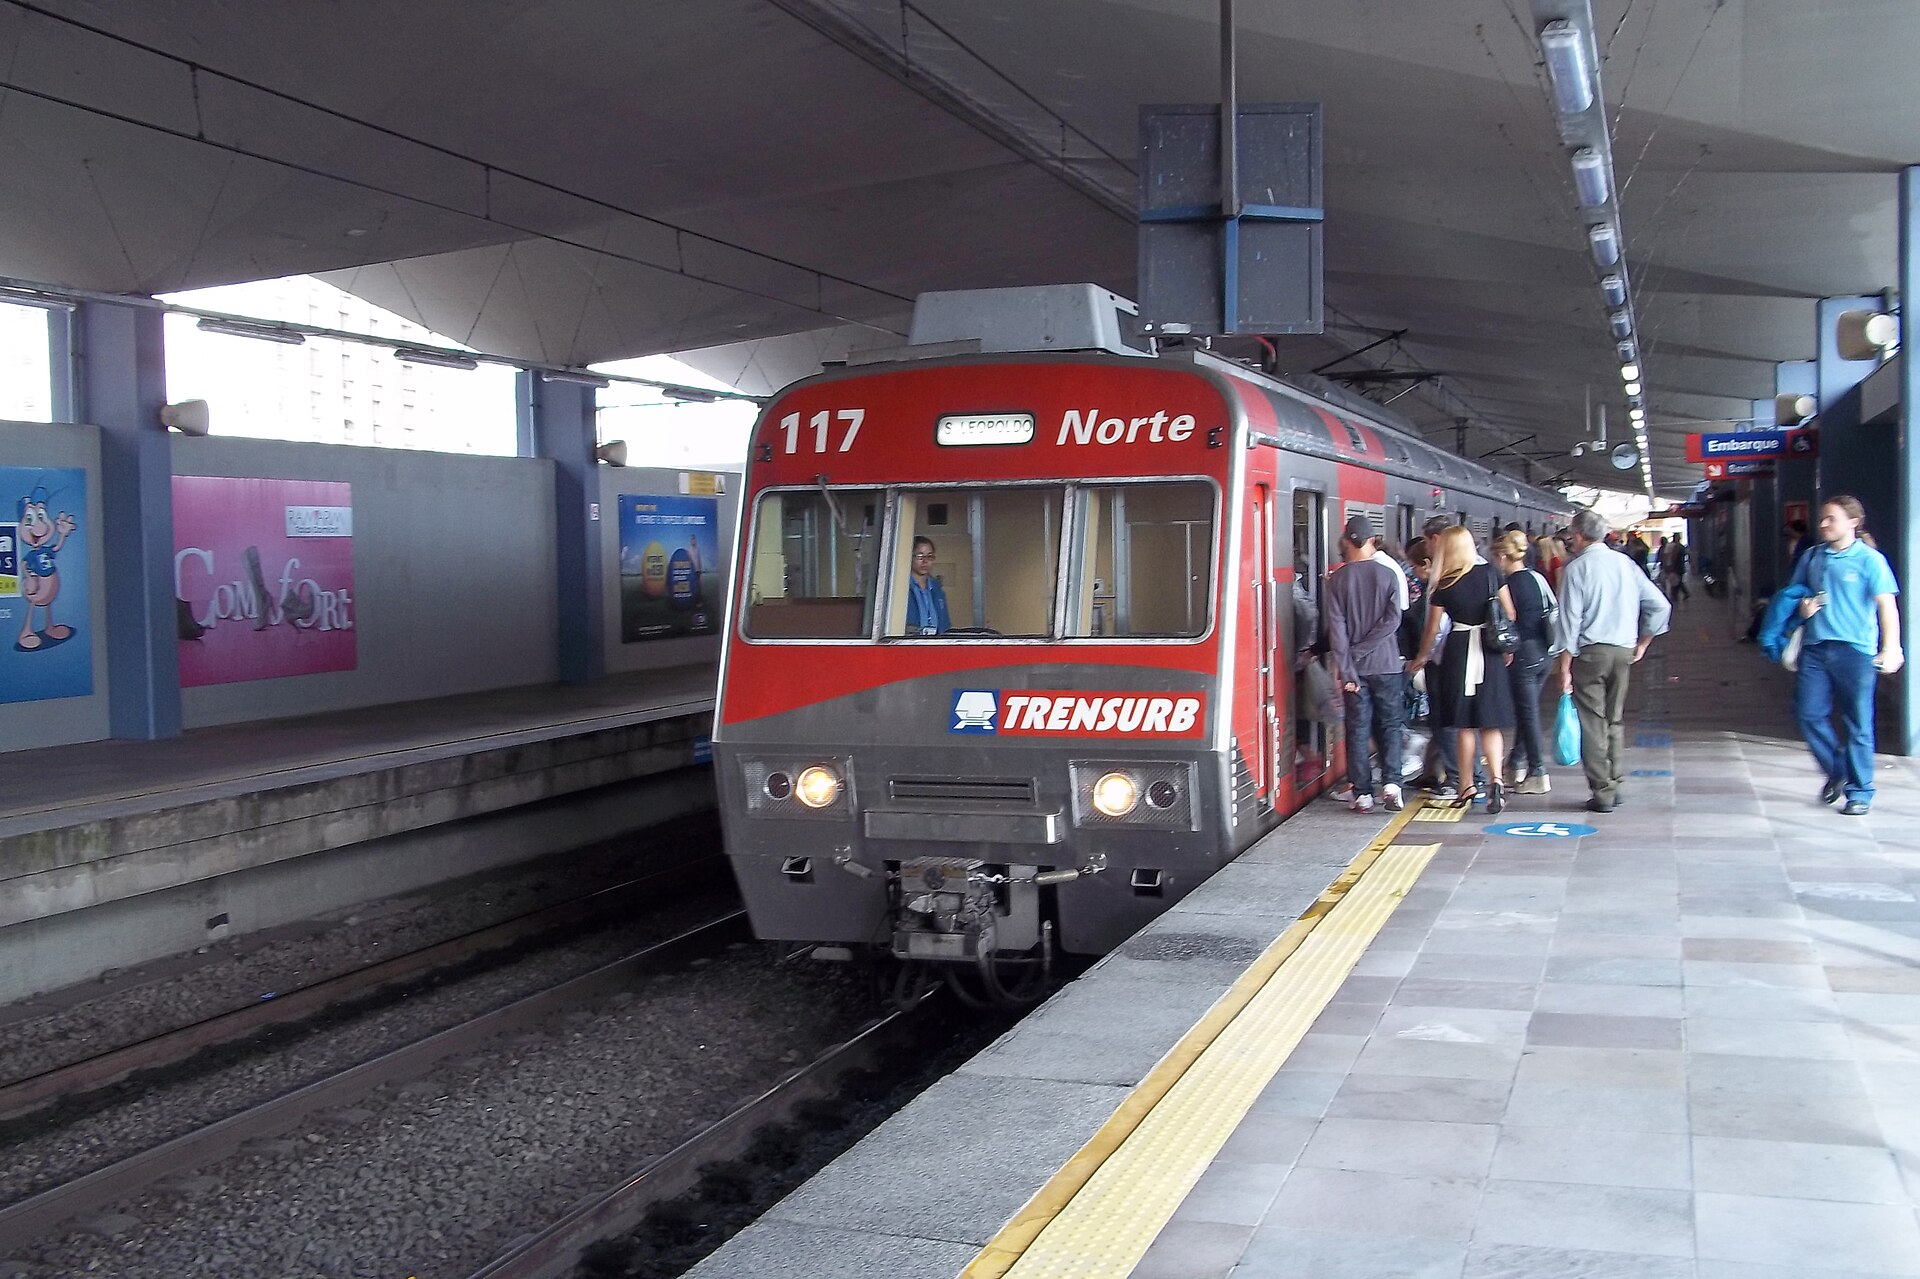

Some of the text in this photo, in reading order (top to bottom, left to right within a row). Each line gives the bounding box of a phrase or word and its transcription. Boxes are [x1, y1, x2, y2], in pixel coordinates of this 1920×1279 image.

[780, 408, 865, 454] 117
[944, 419, 1033, 435] S LEOPOLDO
[1055, 408, 1197, 446] Norte
[1707, 438, 1780, 453] Embarque
[1002, 696, 1200, 732] TRENSURB
